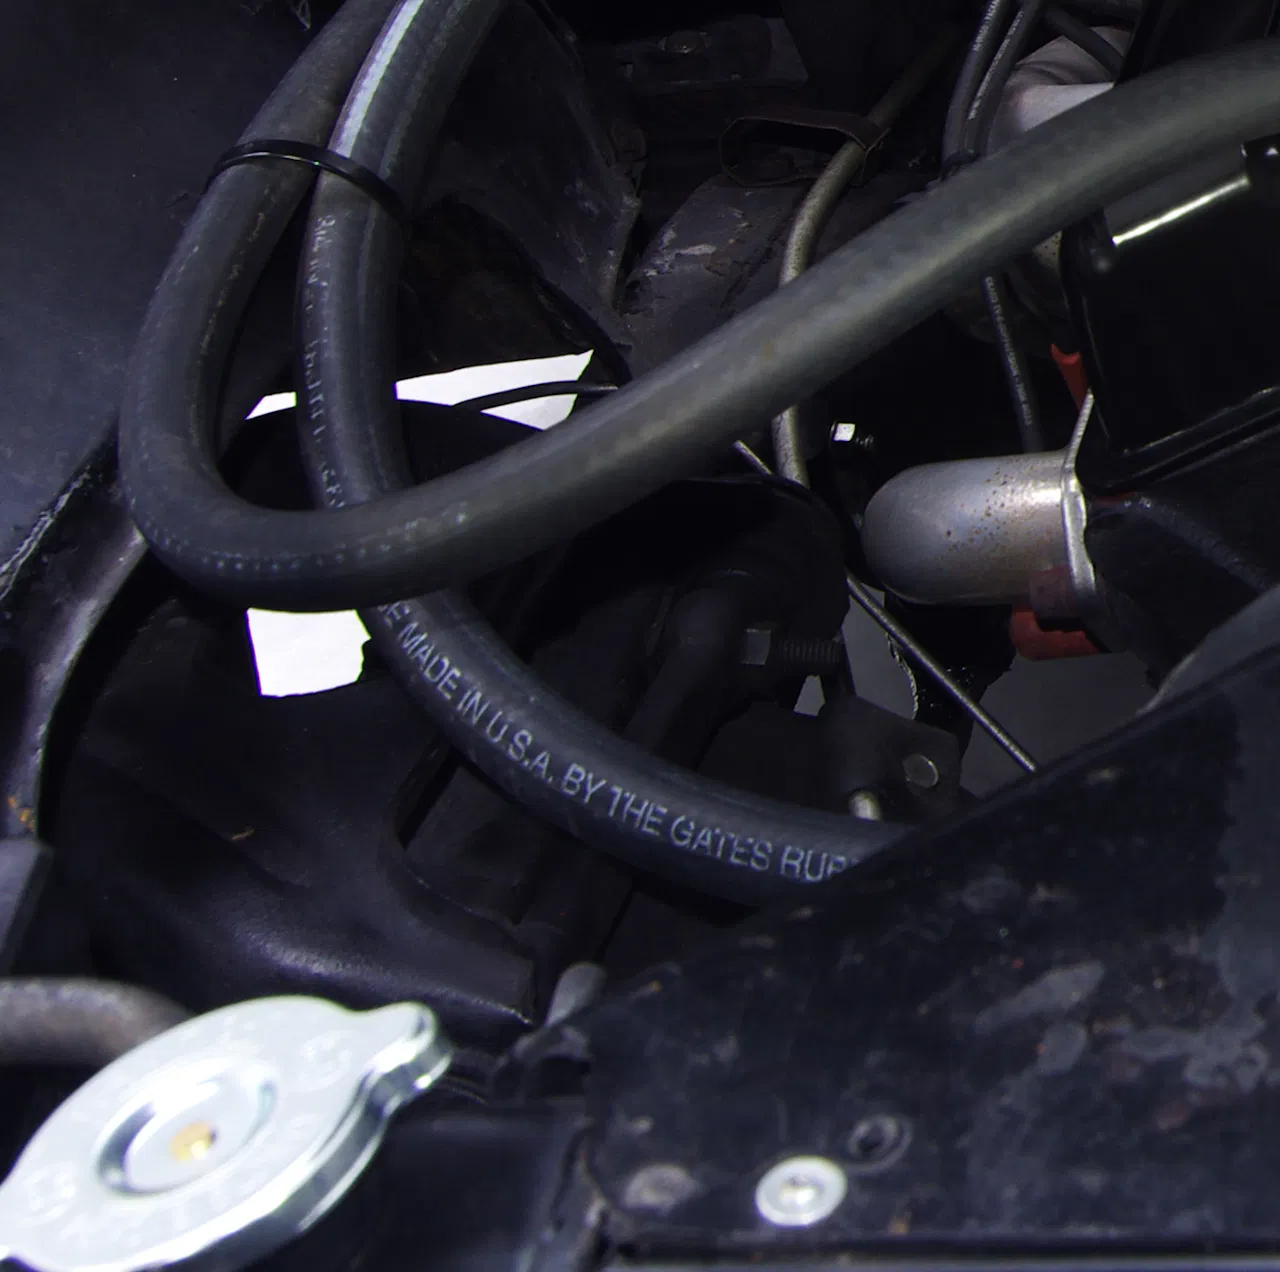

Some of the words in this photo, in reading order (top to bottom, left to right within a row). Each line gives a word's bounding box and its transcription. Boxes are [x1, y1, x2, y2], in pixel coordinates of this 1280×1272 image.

[398, 621, 461, 700] MADE
[456, 684, 492, 726] IN
[485, 710, 553, 784] U.S.A.
[560, 762, 607, 804] BY
[607, 784, 669, 836] THE
[669, 814, 773, 871] GATES
